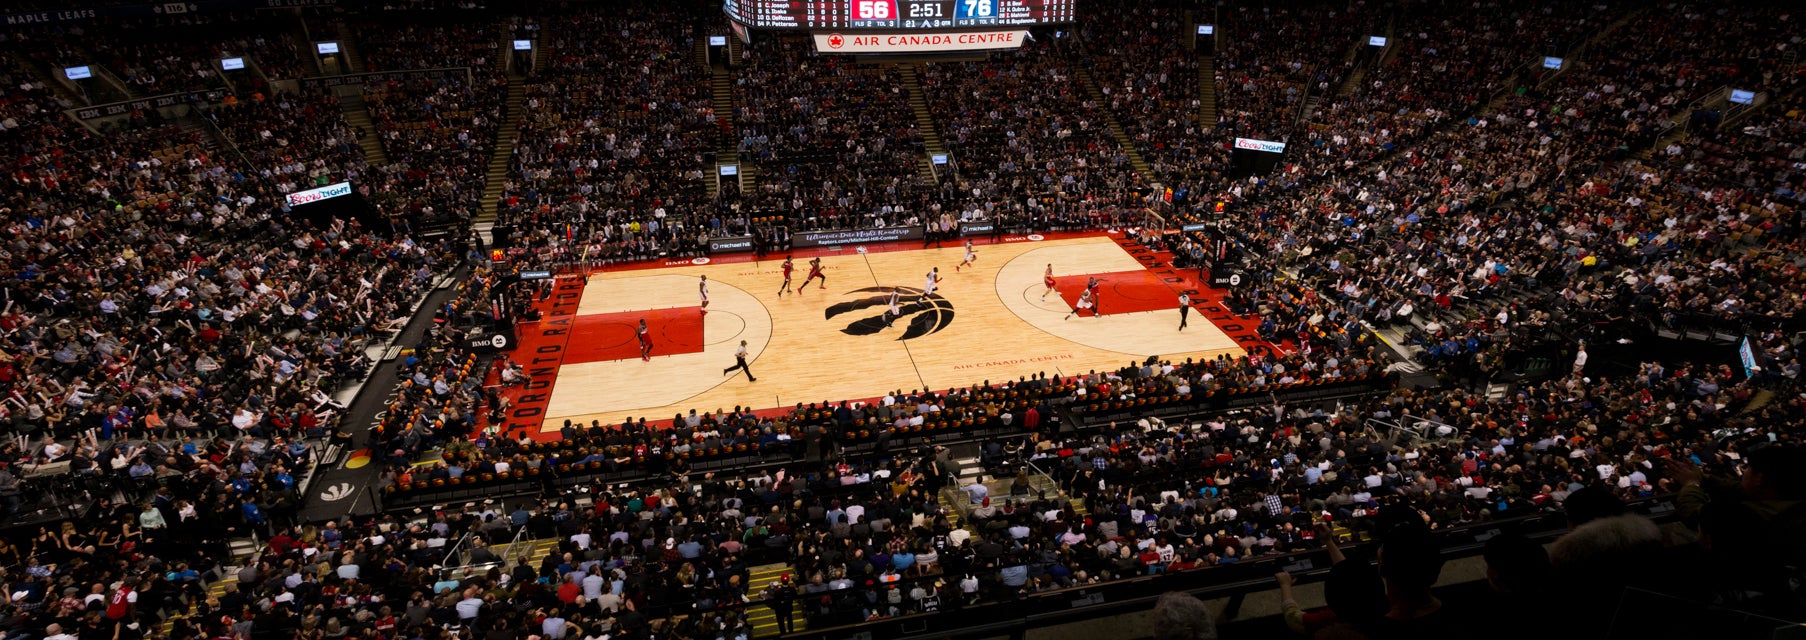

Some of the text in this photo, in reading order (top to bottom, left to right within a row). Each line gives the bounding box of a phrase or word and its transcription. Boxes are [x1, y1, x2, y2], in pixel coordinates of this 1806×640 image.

[167, 4, 183, 12] 116
[859, 1, 889, 18] 56
[910, 3, 943, 17] 2:51
[965, 0, 991, 16] 76
[8, 10, 96, 24] MAPLE LEAFS
[853, 33, 1013, 46] AIR CANADA CENTRE
[79, 108, 99, 120] IBM
[107, 104, 127, 115] IBM
[156, 96, 176, 107] IBM
[1238, 139, 1283, 152] Coors LIGHT
[290, 186, 348, 205] Coors LIGHT
[472, 340, 491, 348] BMO
[976, 359, 1026, 367] CANADA
[1030, 354, 1074, 362] CENTRE
[508, 345, 562, 432] TORONTO
